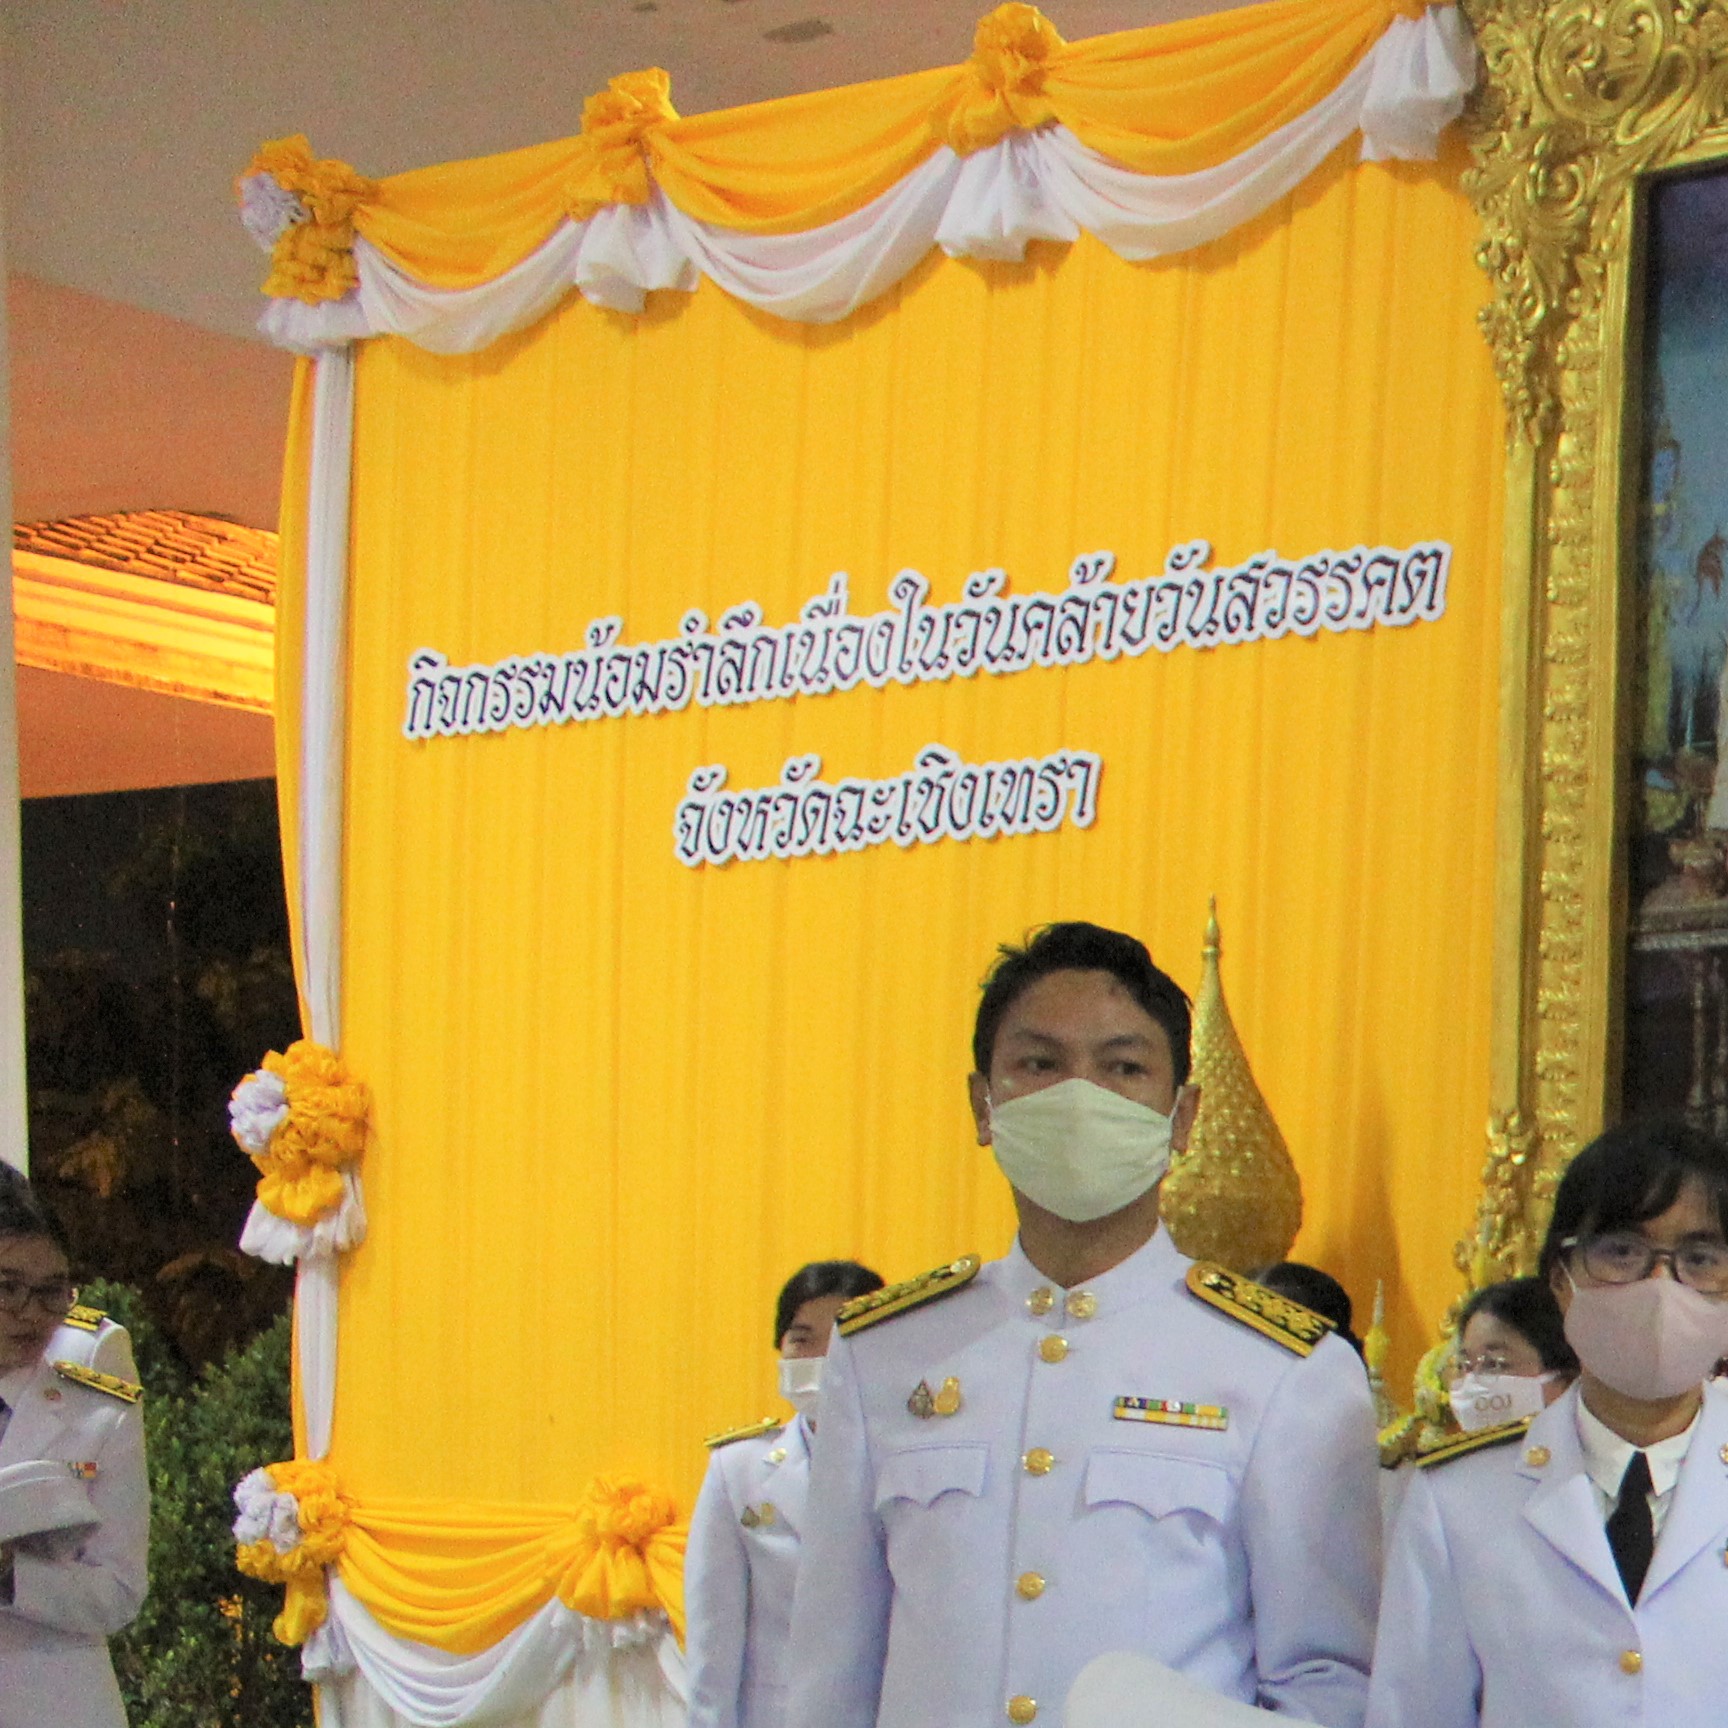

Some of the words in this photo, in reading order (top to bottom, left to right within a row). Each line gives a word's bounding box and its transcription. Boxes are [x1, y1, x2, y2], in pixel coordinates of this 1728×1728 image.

[404, 543, 1445, 735] กิจกรรมน้อมรำลึกเนื่องในวันคล้ายวันสวรรคต
[678, 749, 1093, 860] จังหวัดฉะเชิงเทรา
